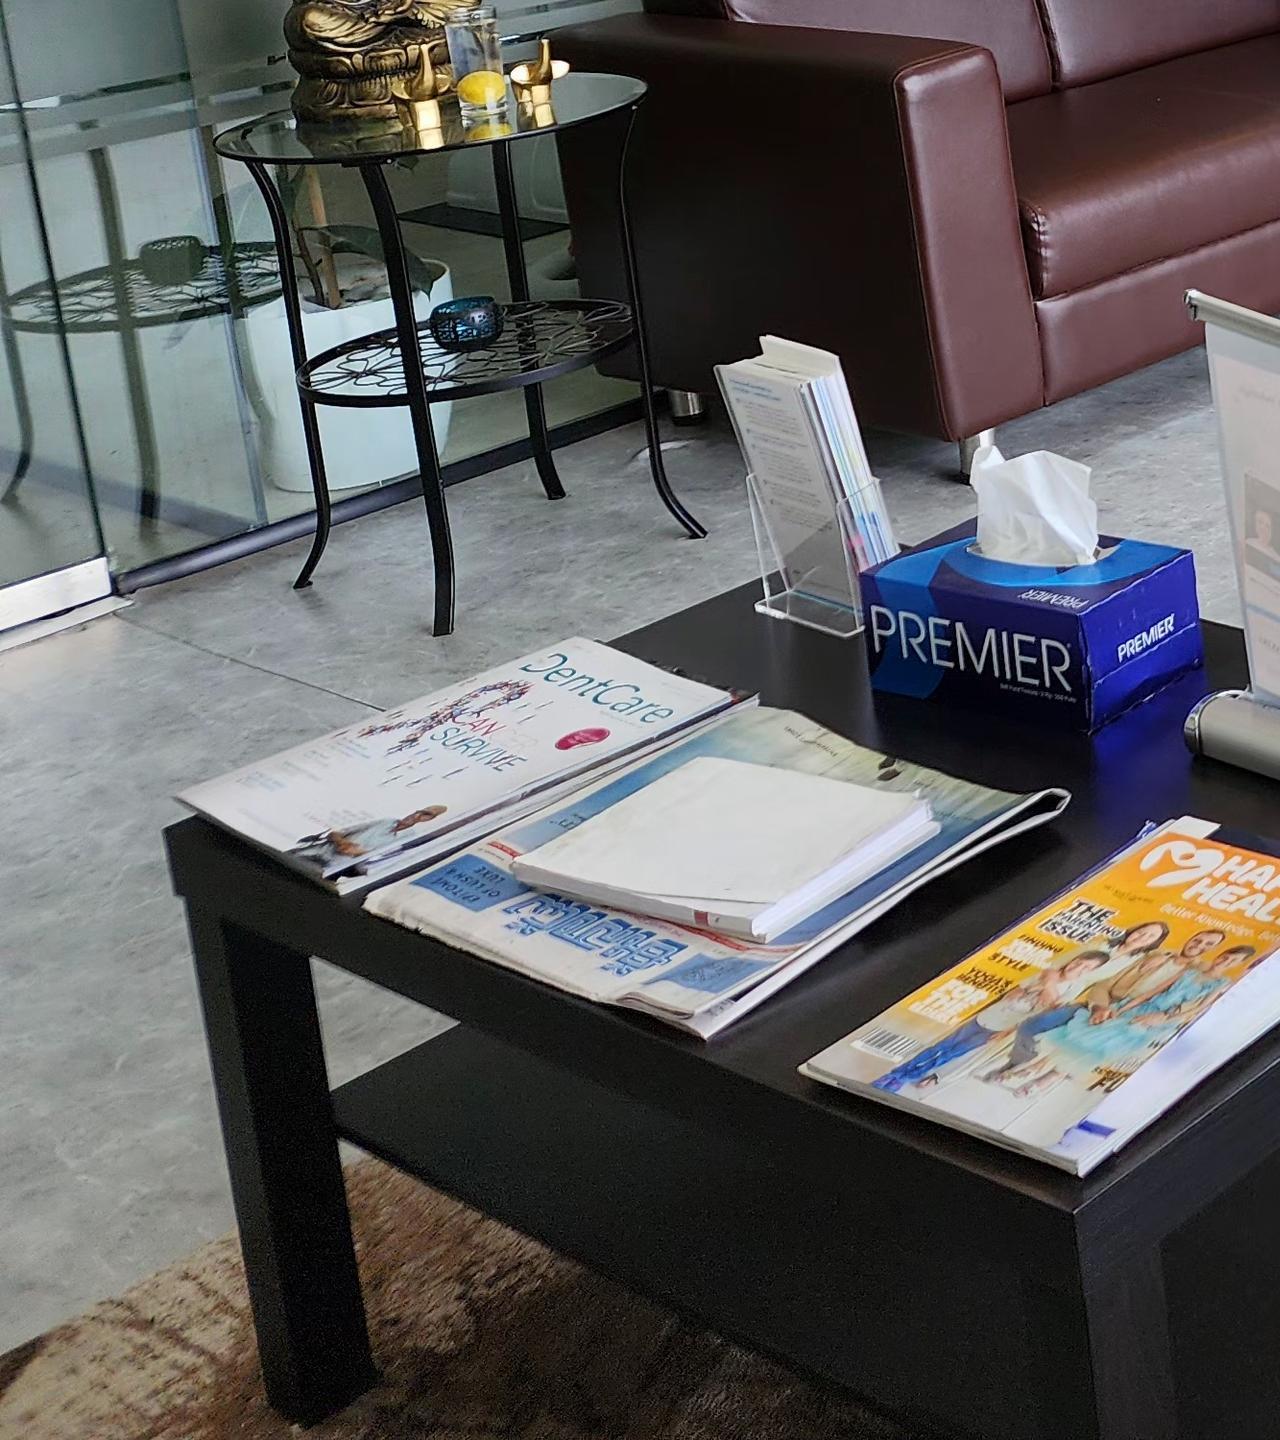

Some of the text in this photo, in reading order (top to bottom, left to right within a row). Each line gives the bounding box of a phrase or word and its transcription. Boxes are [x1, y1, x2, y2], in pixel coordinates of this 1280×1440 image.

[1019, 588, 1091, 610] PREMIER
[1117, 613, 1175, 663] PREMIER
[519, 653, 674, 724] DentCare
[441, 727, 528, 771] SURVIVE
[473, 866, 506, 881] LUXE
[1076, 900, 1118, 921] THE
[1038, 920, 1094, 943] ISSUE
[987, 951, 1031, 972] STYLE
